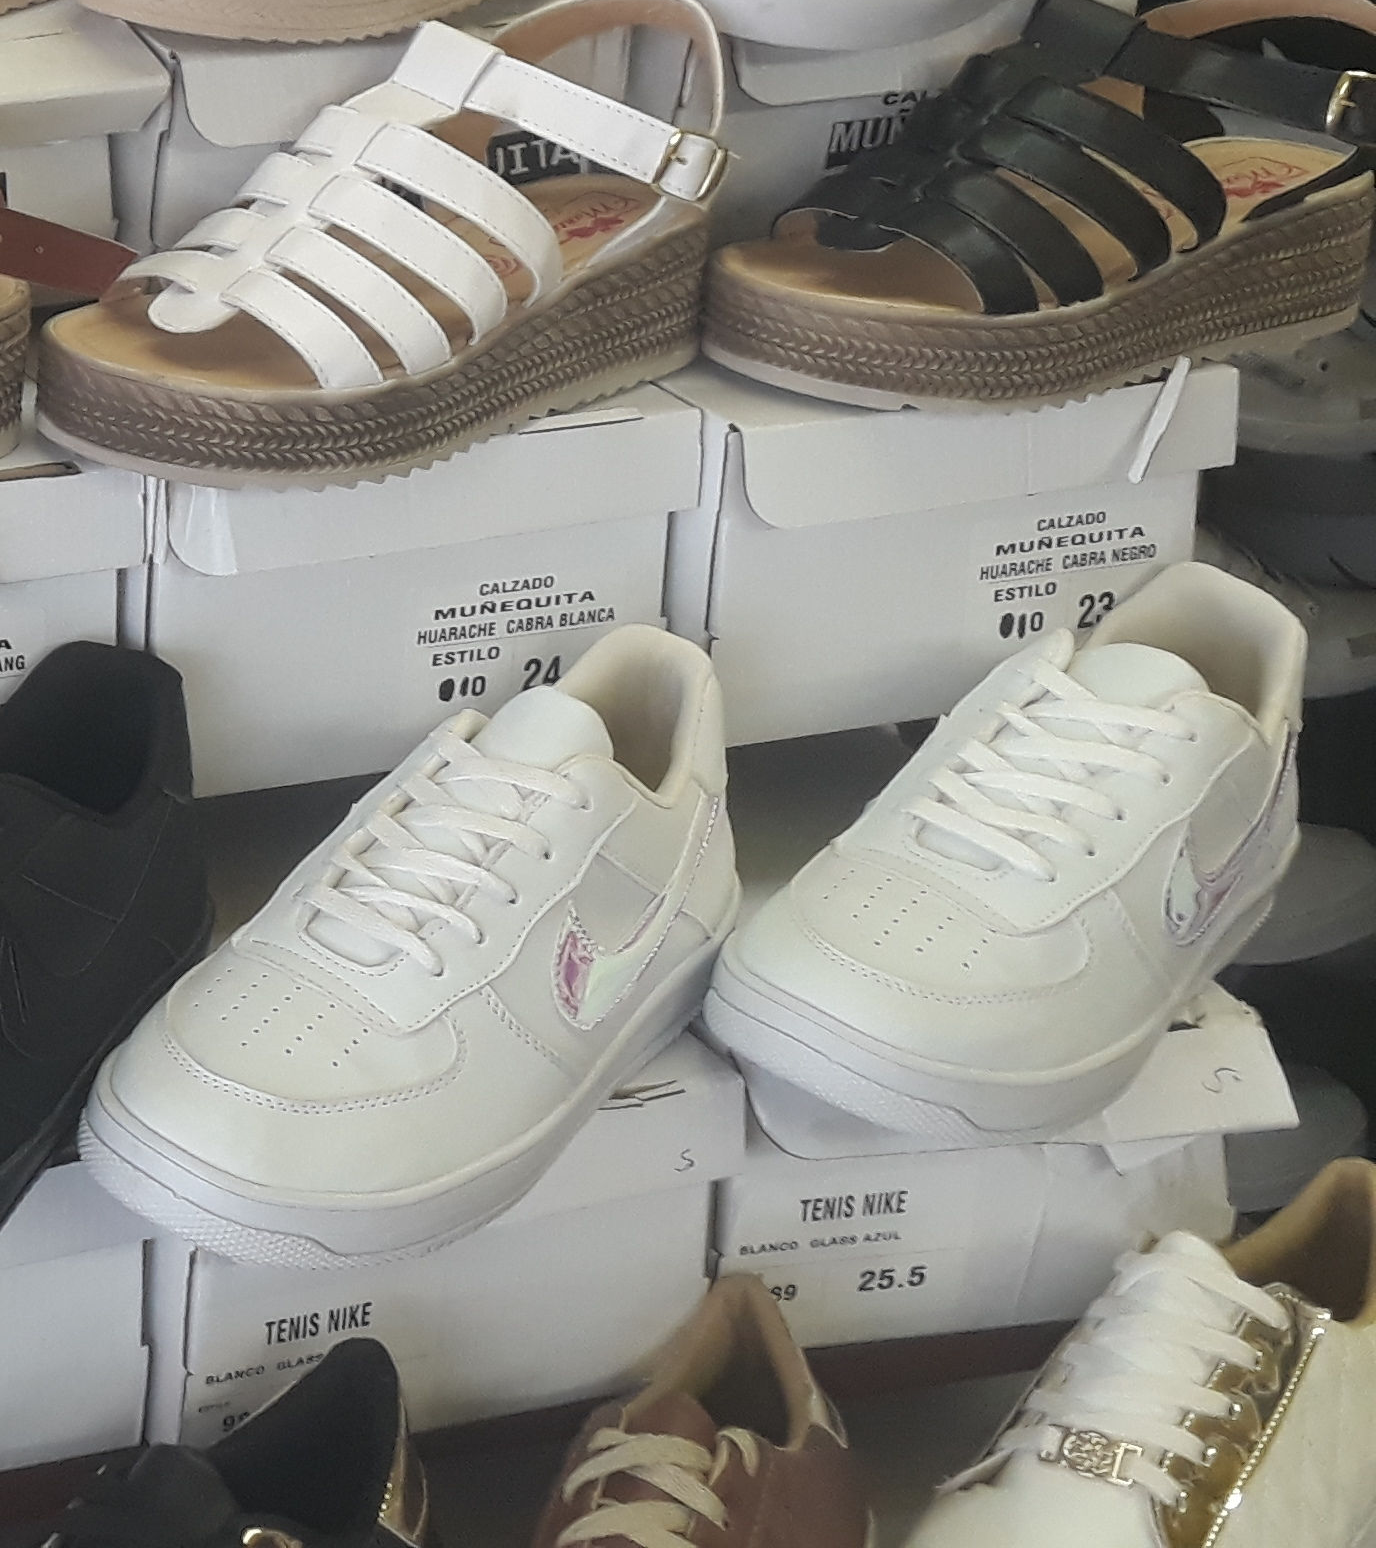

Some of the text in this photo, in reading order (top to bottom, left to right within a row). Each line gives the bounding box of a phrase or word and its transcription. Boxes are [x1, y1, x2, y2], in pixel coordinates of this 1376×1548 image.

[1037, 511, 1107, 532] CALZADO
[995, 526, 1146, 557] MUÑEQUITA
[980, 544, 1157, 580] HUARACHE CABRA NEGRO
[479, 575, 555, 596] CALZADO
[994, 582, 1057, 602] ESTILO
[433, 590, 596, 621] MUÑEQUITA
[417, 607, 616, 645] HUARACHE CABRA BLANCA
[432, 646, 501, 667] ESTILO
[522, 655, 561, 691] 24
[800, 1190, 909, 1223] TENIS NIKE
[738, 1240, 799, 1256] BLANCO
[862, 1230, 903, 1243] AZUL
[856, 1265, 929, 1293] 25.5
[265, 1301, 373, 1345] TENIS NIKE
[205, 1365, 266, 1385] BLANCO
